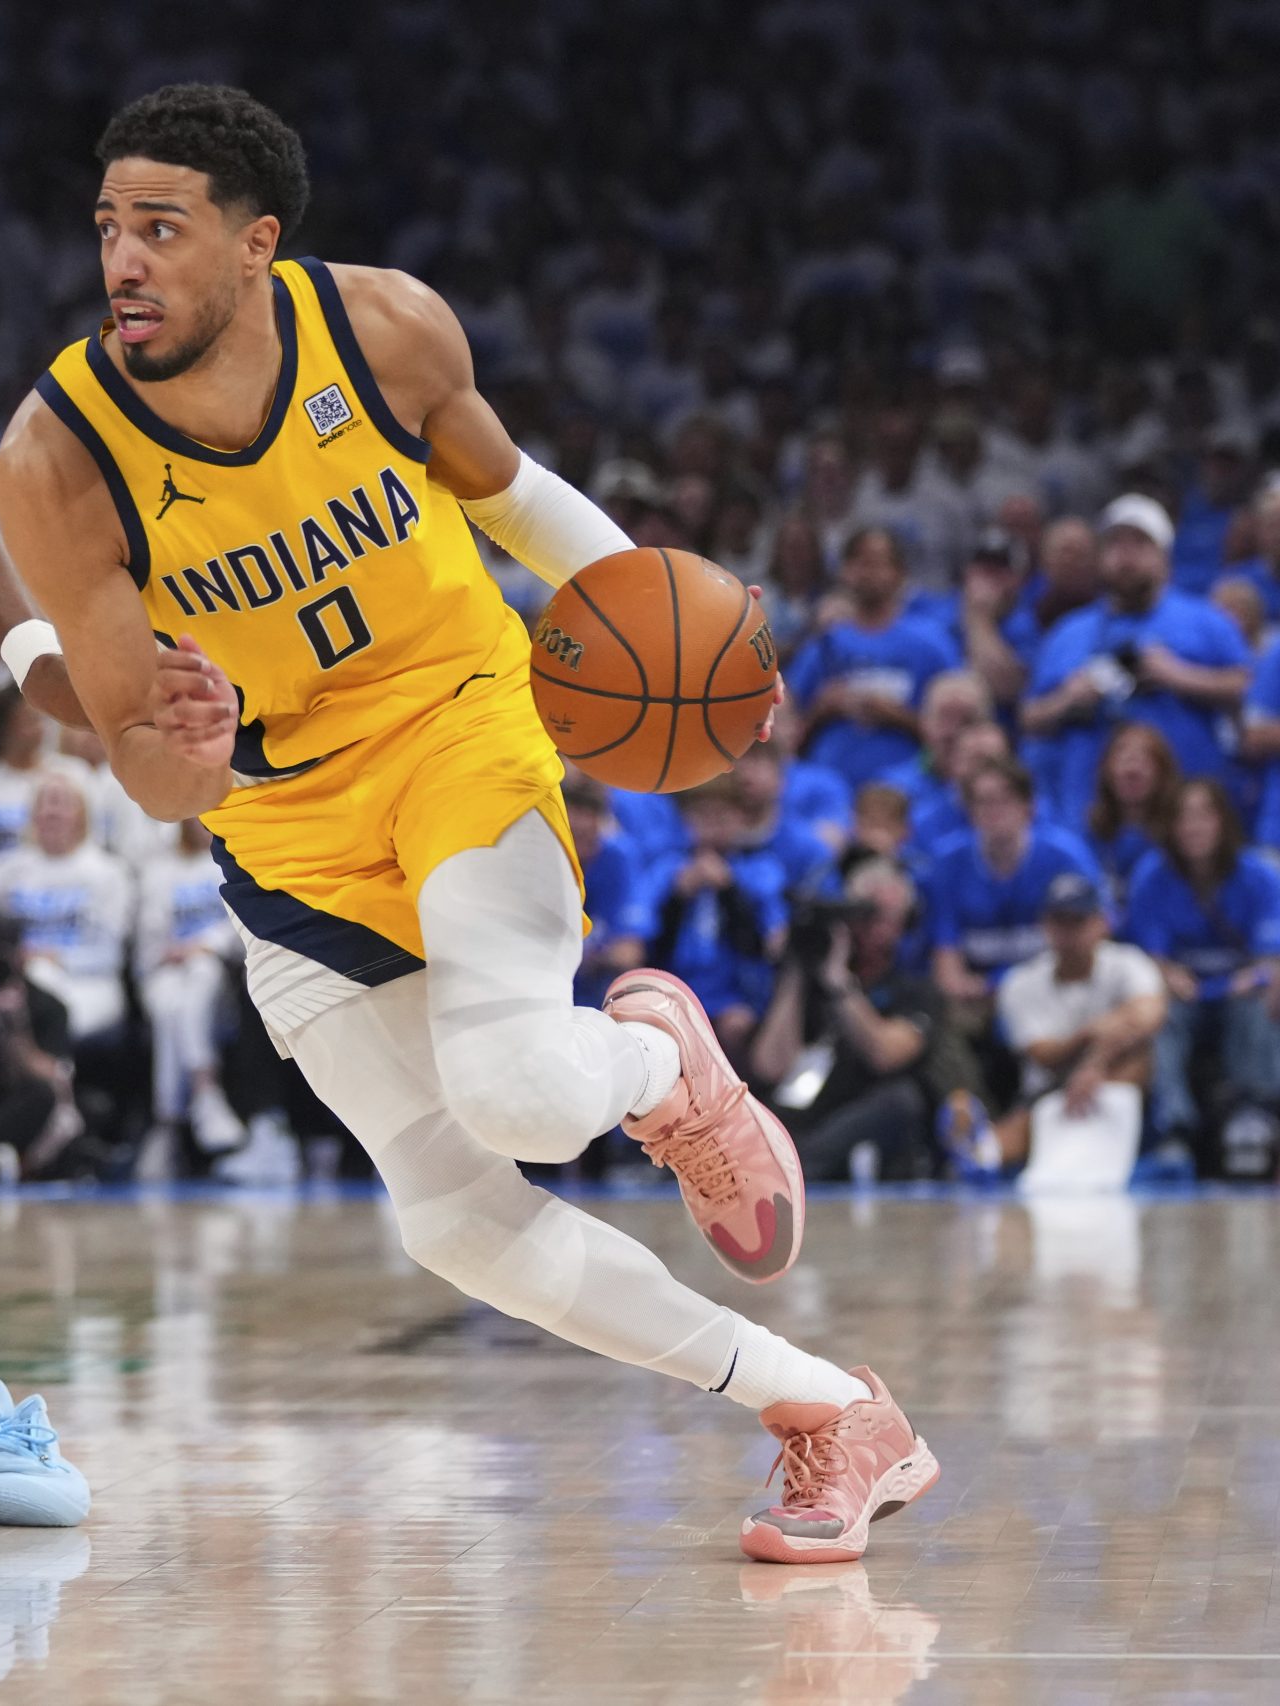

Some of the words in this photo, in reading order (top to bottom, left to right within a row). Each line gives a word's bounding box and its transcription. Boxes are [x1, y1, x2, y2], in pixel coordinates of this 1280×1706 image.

[318, 420, 362, 449] spokenote
[161, 467, 419, 617] INDIANA
[296, 585, 374, 670] 0
